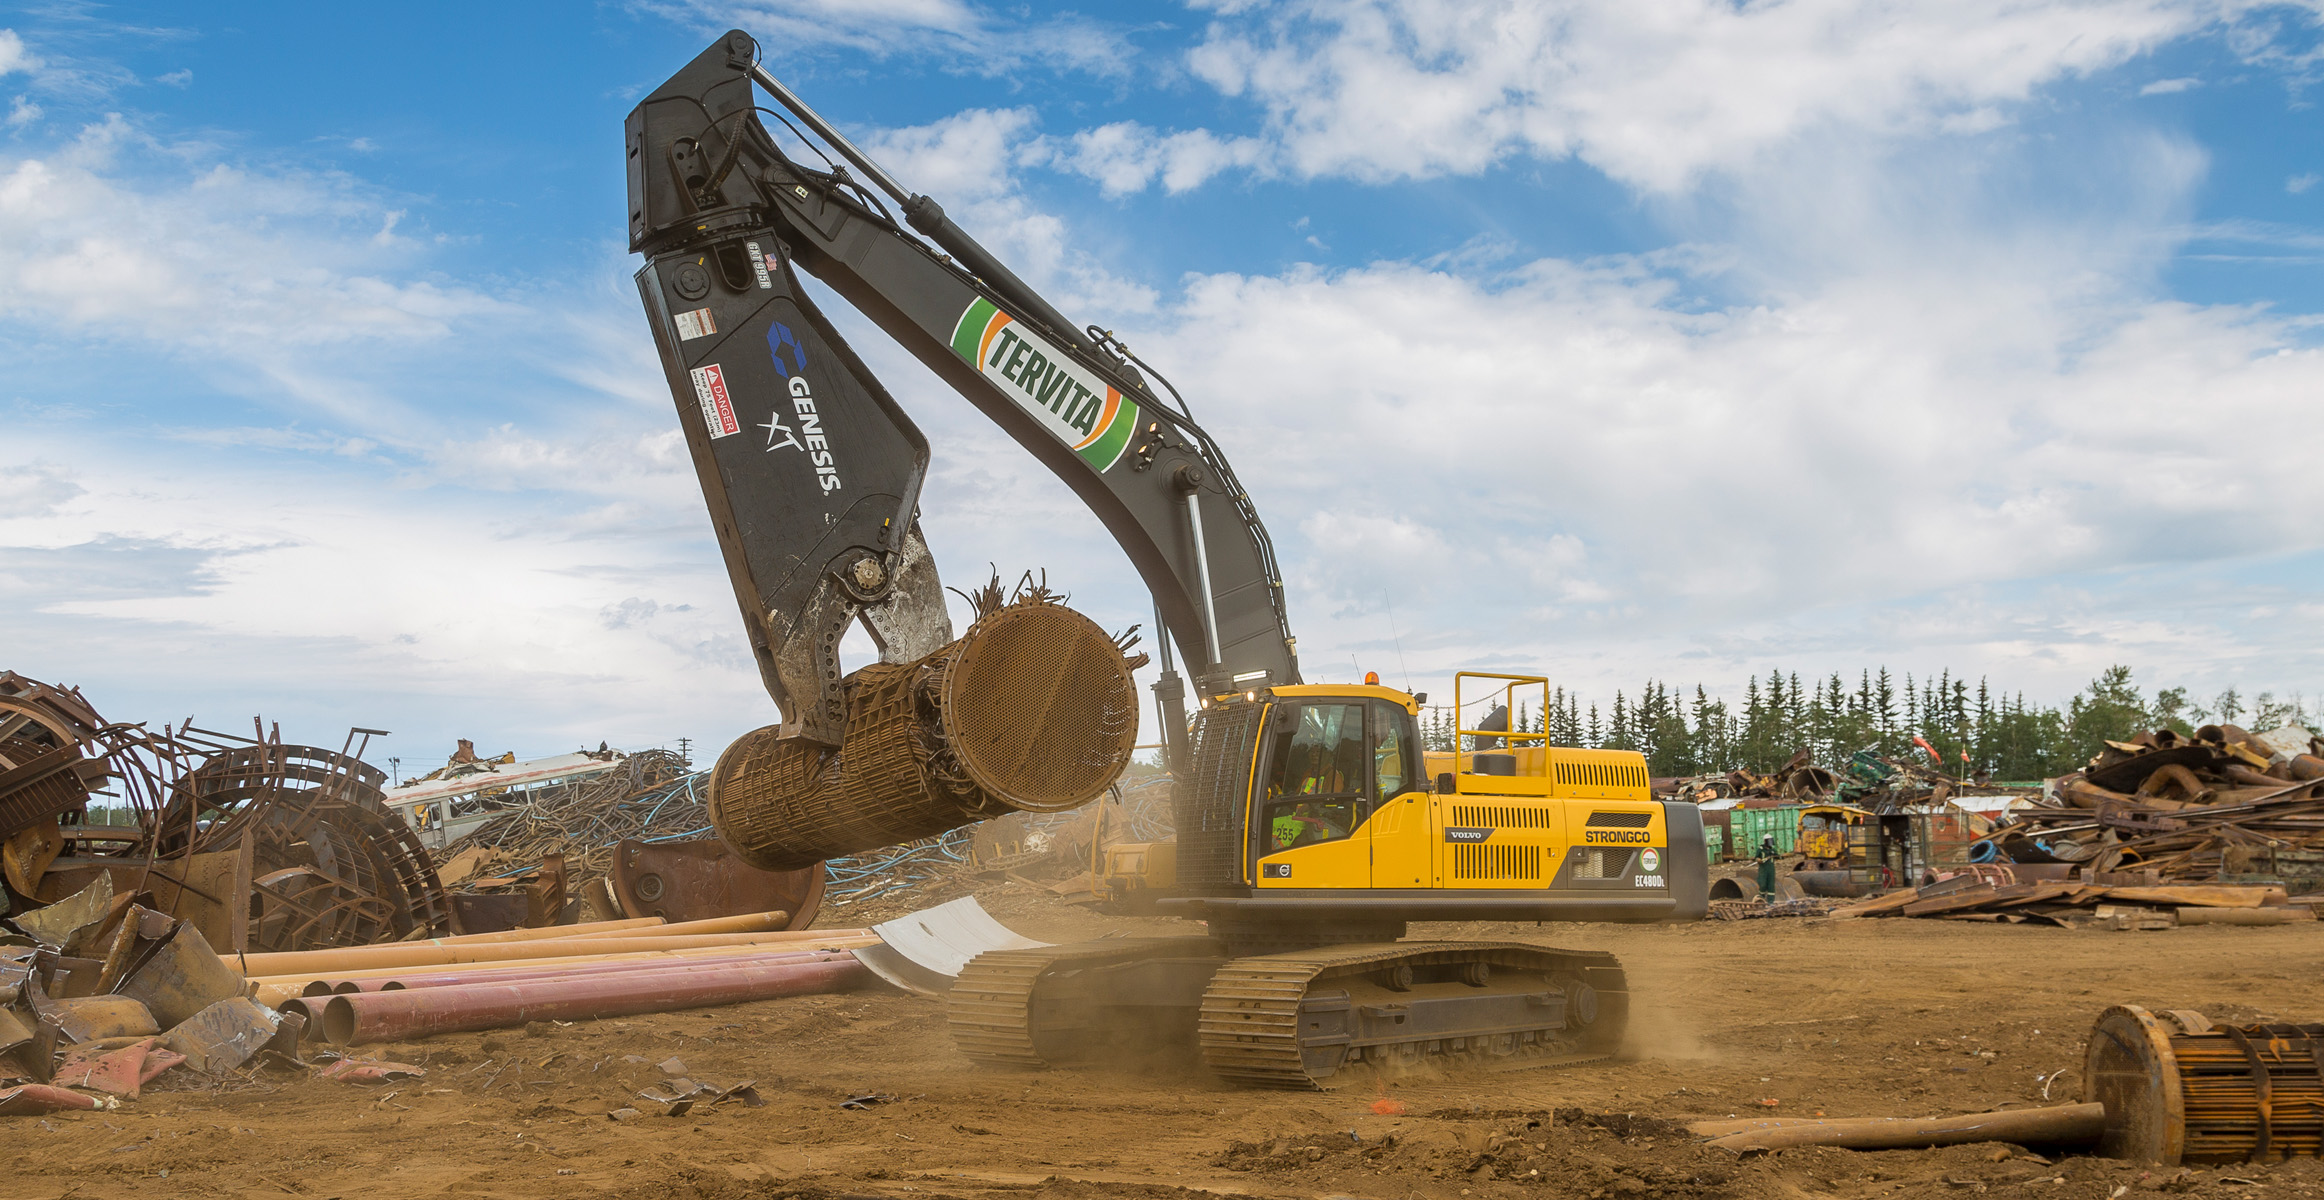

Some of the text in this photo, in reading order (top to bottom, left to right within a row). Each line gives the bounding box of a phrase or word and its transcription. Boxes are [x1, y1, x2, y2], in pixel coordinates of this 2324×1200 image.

[692, 371, 700, 387] away
[698, 388, 707, 408] during
[700, 373, 708, 388] Keep
[705, 390, 711, 398] 75
[708, 400, 716, 413] Feet
[989, 327, 1102, 437] TERVITA
[713, 386, 735, 431] DANGER
[788, 376, 841, 491] GENESIS
[1277, 828, 1293, 841] 255
[1585, 831, 1650, 843] STRONGCO
